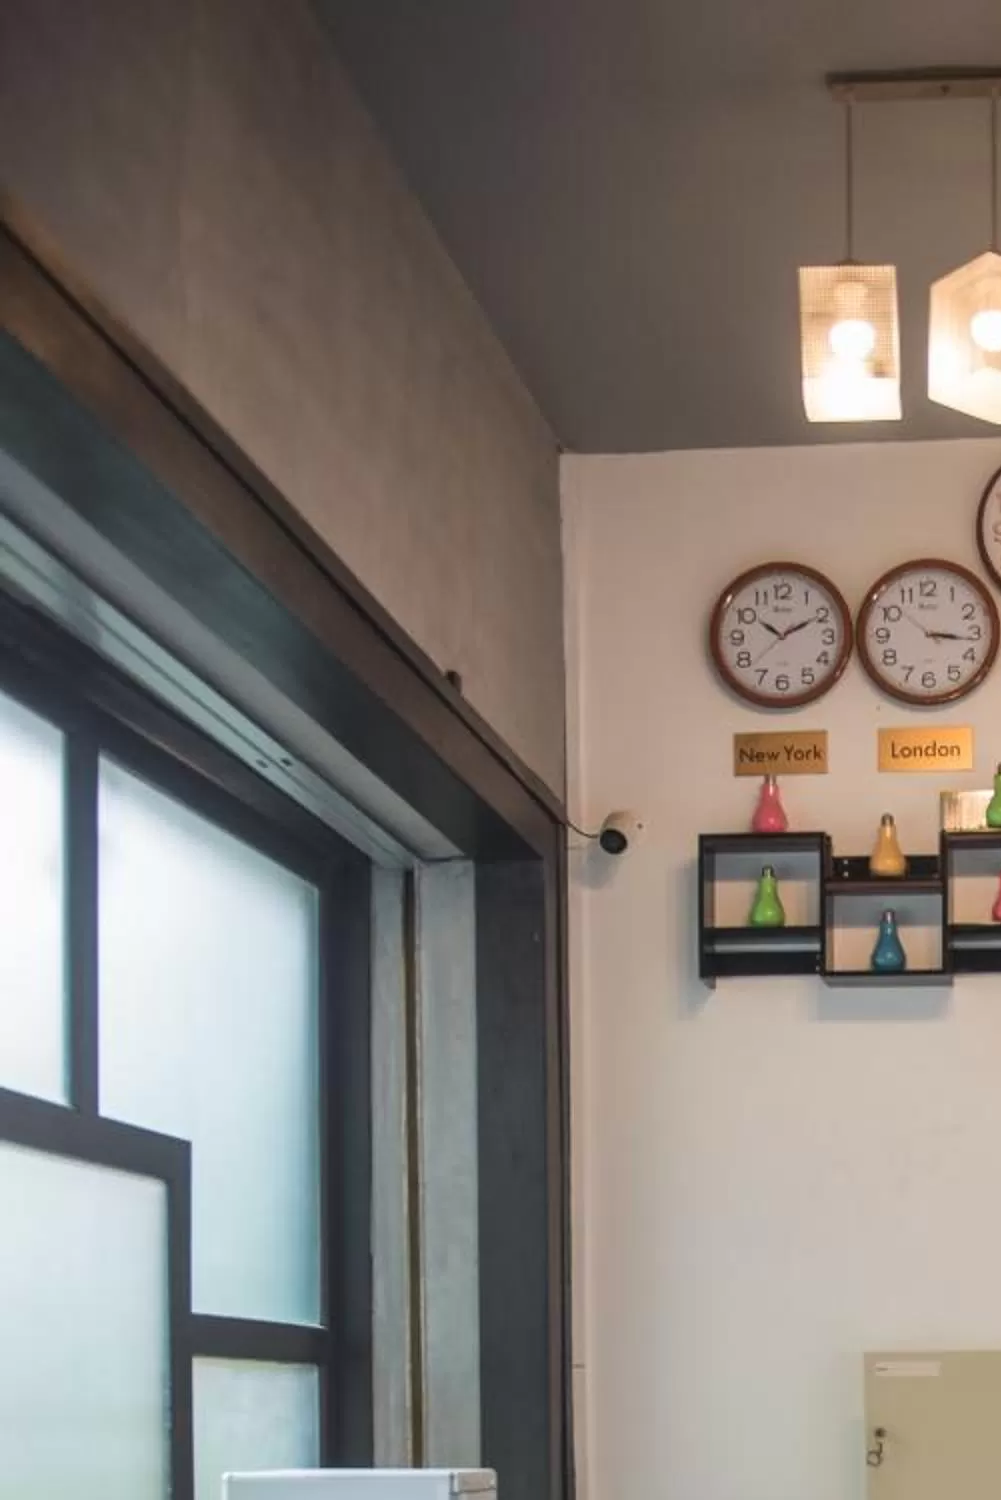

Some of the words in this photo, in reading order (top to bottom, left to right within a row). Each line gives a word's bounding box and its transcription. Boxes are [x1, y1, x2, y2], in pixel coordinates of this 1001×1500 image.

[774, 583, 792, 600] 12
[901, 588, 913, 604] 11
[920, 581, 936, 597] 12
[755, 591, 768, 605] 11
[737, 607, 757, 624] 10
[816, 607, 829, 623] 2
[883, 605, 902, 622] 10
[962, 604, 976, 620] 2
[731, 630, 745, 645] 9
[822, 629, 835, 645] 3
[876, 628, 890, 644] 9
[968, 625, 981, 641] 3
[736, 652, 751, 668] 8
[816, 651, 829, 665] 4
[883, 649, 897, 665] 8
[963, 647, 976, 663] 4
[755, 669, 768, 685] 7
[802, 668, 815, 684] 5
[902, 666, 915, 682] 7
[922, 672, 936, 688] 6
[948, 666, 960, 682] 5
[776, 675, 790, 690] 6
[739, 747, 780, 763] New
[783, 743, 825, 761] York
[890, 740, 962, 759] London
